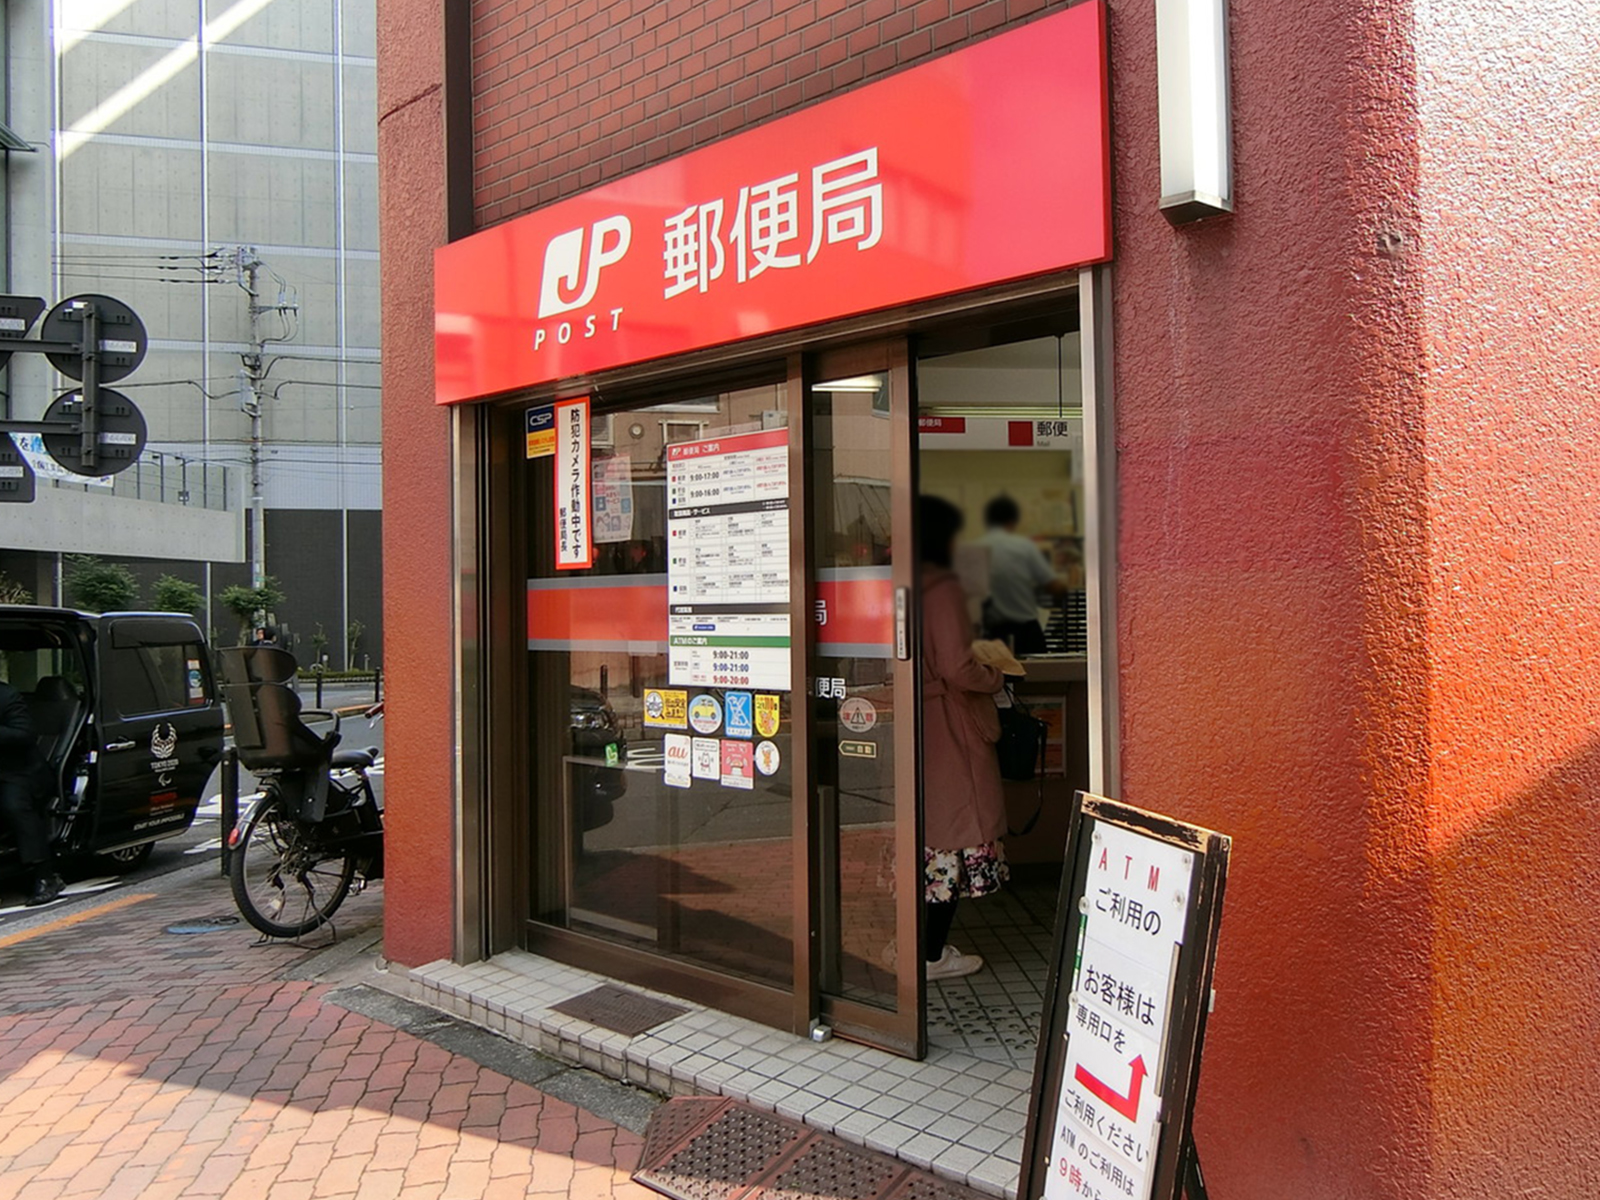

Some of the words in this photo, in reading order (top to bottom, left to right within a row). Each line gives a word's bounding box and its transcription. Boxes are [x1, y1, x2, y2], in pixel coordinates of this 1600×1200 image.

[663, 147, 884, 299] 郵便局
[538, 215, 632, 319] JP
[534, 307, 623, 350] POST
[530, 412, 552, 426] CSP
[1037, 421, 1068, 437] 郵便
[570, 408, 582, 559] 防犯カメラ作動中です
[690, 471, 720, 481] 9:00-17:00
[690, 488, 720, 498] 9:00-16:00
[559, 507, 568, 552] 郵便局長
[713, 651, 749, 660] 9:00-21:00
[713, 663, 749, 672] 9:00-21:00
[713, 676, 749, 685] 9:00-20:00
[668, 746, 688, 759] au
[1098, 848, 1160, 892] ATM
[1096, 888, 1162, 935] ご利用の
[1084, 964, 1156, 1026] お客様は
[1075, 1003, 1126, 1054] 専用口を
[1065, 1088, 1149, 1163] ご利用ください
[1060, 1125, 1076, 1150] ATM
[1078, 1143, 1134, 1197] のご利用は
